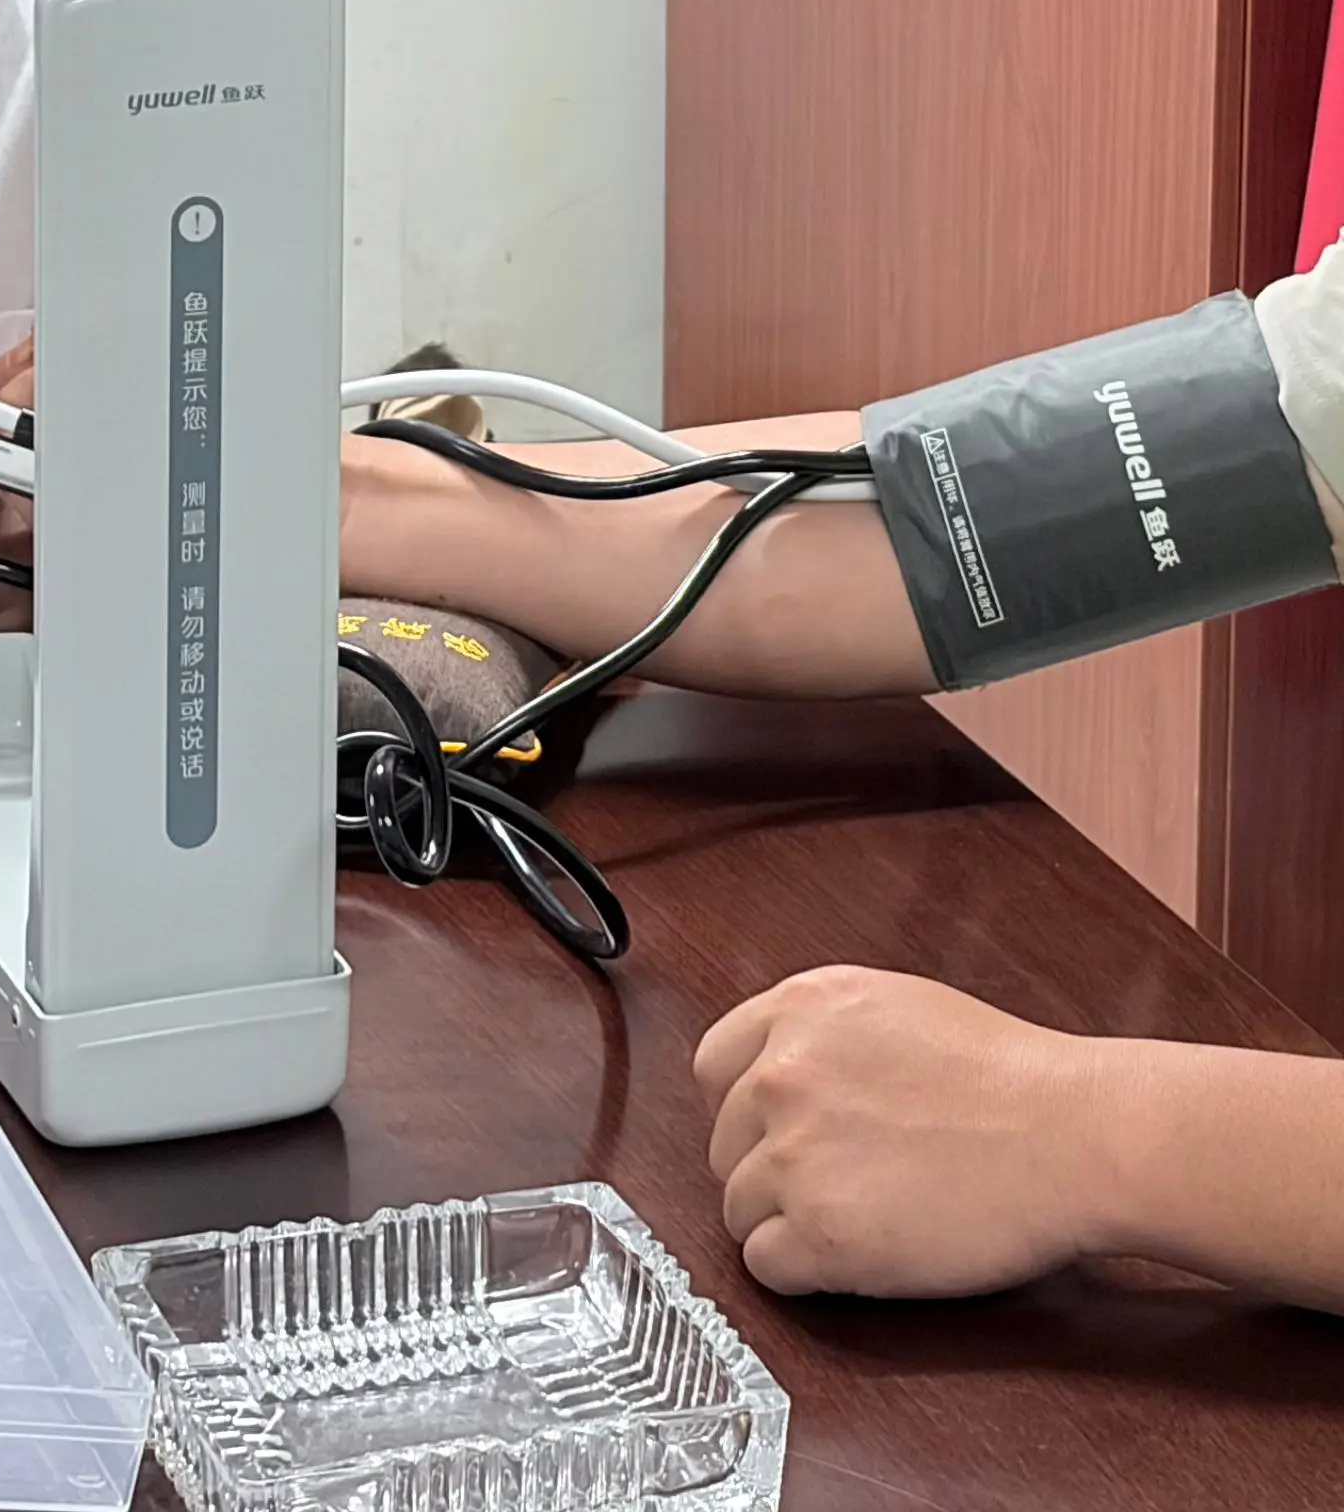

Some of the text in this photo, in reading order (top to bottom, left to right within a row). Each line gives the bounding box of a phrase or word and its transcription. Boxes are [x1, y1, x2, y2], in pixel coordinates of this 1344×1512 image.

[127, 84, 266, 116] yuwell 鱼跃
[180, 291, 209, 779] 鱼跃提示您： 测量时 请勿移动或说话
[1093, 380, 1181, 572] yuwell 鱼跃
